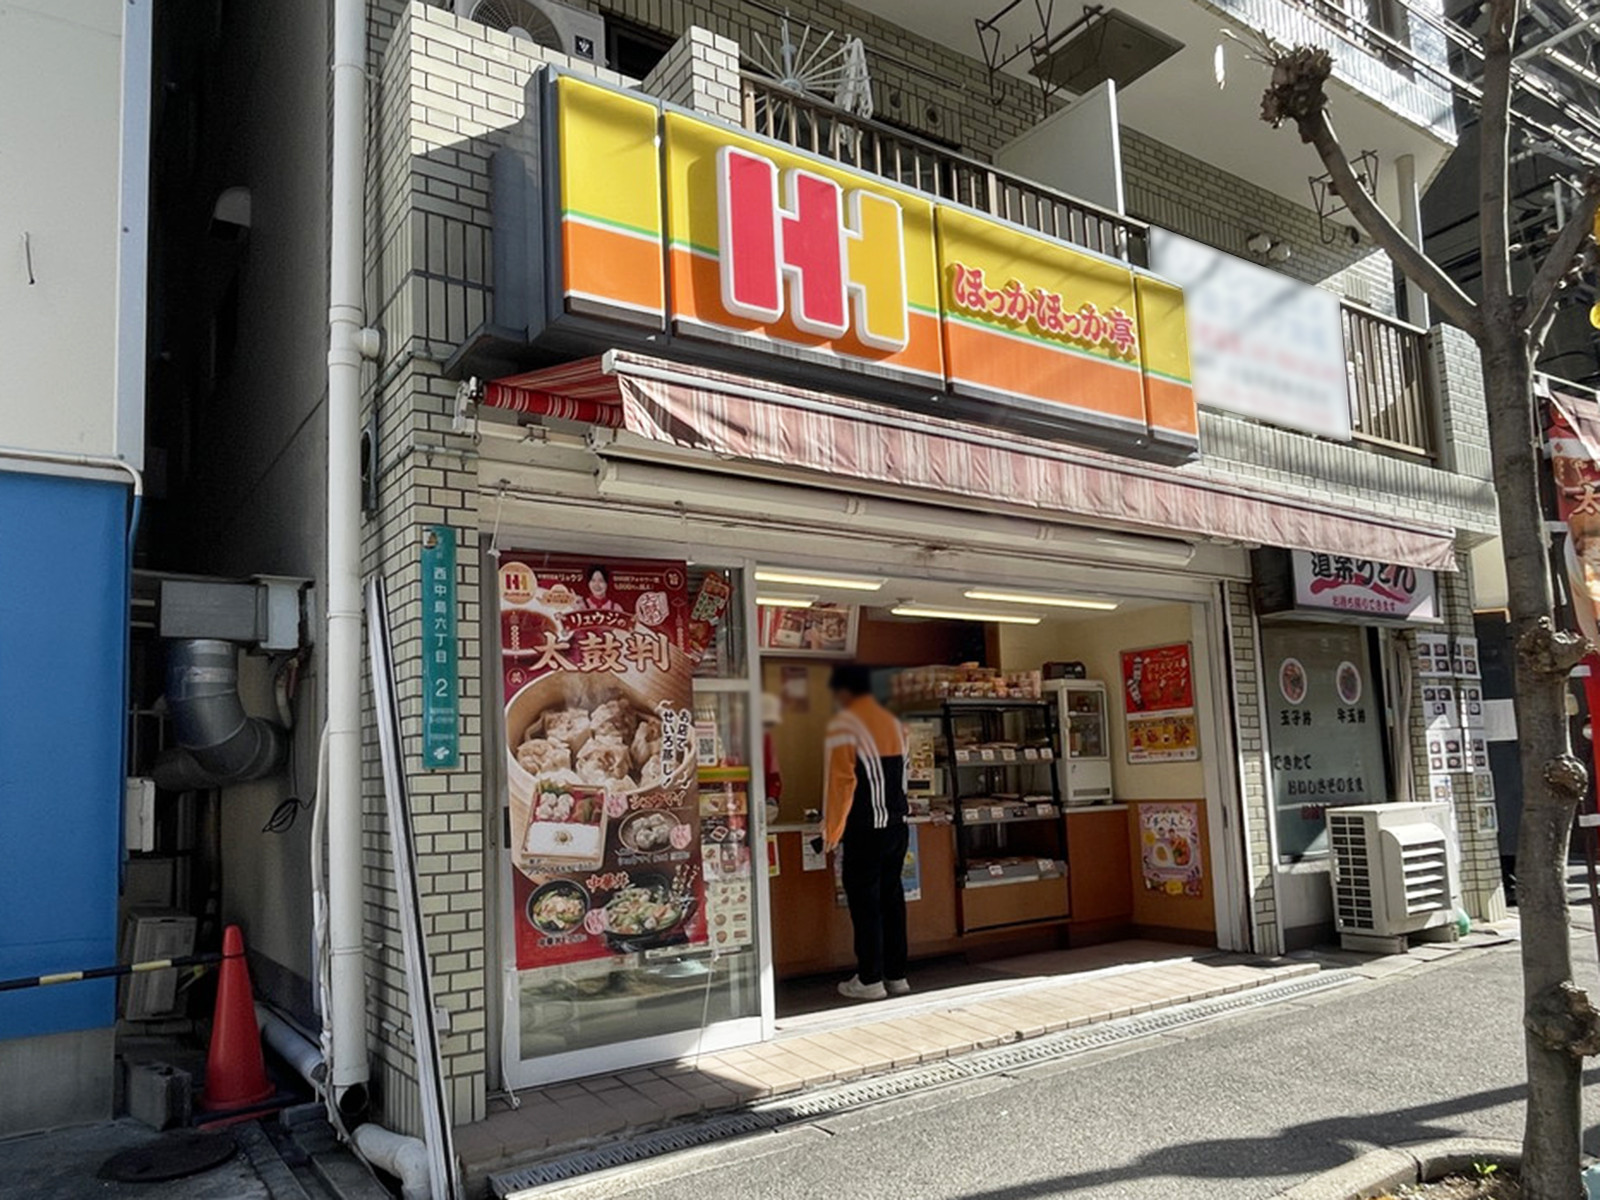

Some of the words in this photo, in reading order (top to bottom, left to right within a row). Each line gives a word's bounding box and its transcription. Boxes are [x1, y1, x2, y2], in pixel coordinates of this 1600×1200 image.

[951, 261, 1138, 355] ほっかほっか亭
[433, 566, 448, 663] 西中島六丁目
[571, 611, 627, 628] リュウジの
[529, 631, 672, 673] 太鼓判
[435, 678, 448, 696] 2
[676, 710, 689, 750] お店で
[1273, 754, 1312, 771] できたて
